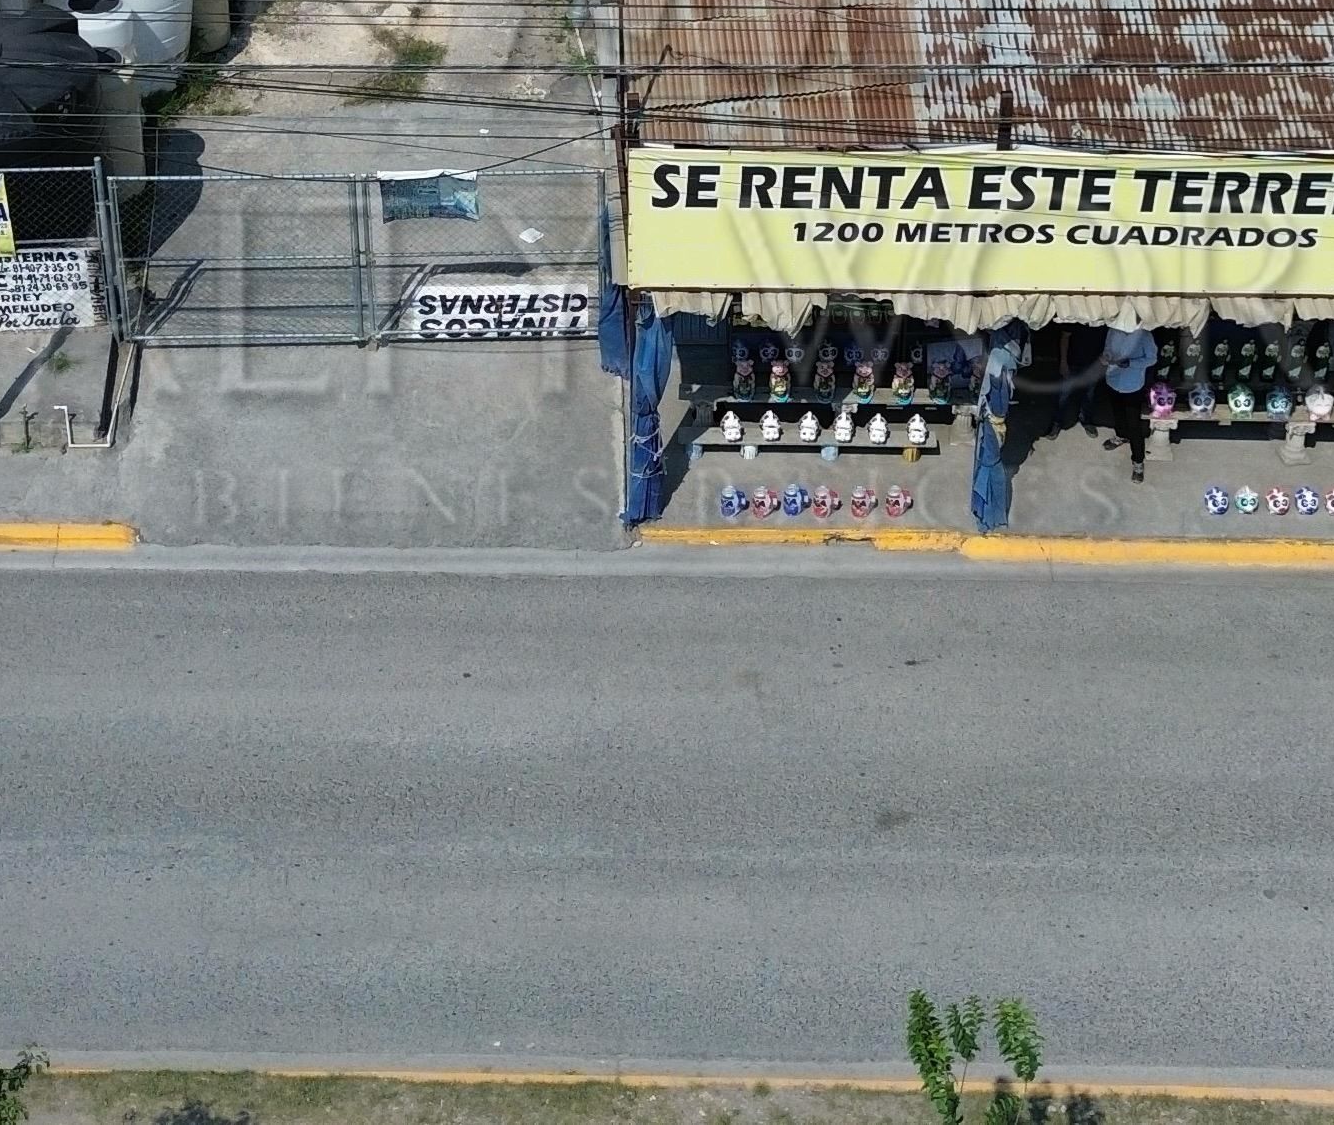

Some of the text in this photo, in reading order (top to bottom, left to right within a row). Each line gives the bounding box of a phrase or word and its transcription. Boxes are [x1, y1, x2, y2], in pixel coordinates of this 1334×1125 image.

[651, 164, 718, 208] SE
[739, 166, 949, 209] RENTA
[968, 167, 1111, 212] ESTE
[794, 222, 1318, 248] 1200 METROS CUADRADOS
[418, 293, 588, 315] CISTERNAS
[23, 311, 81, 326] Jaula
[419, 316, 584, 338] TINACOS
